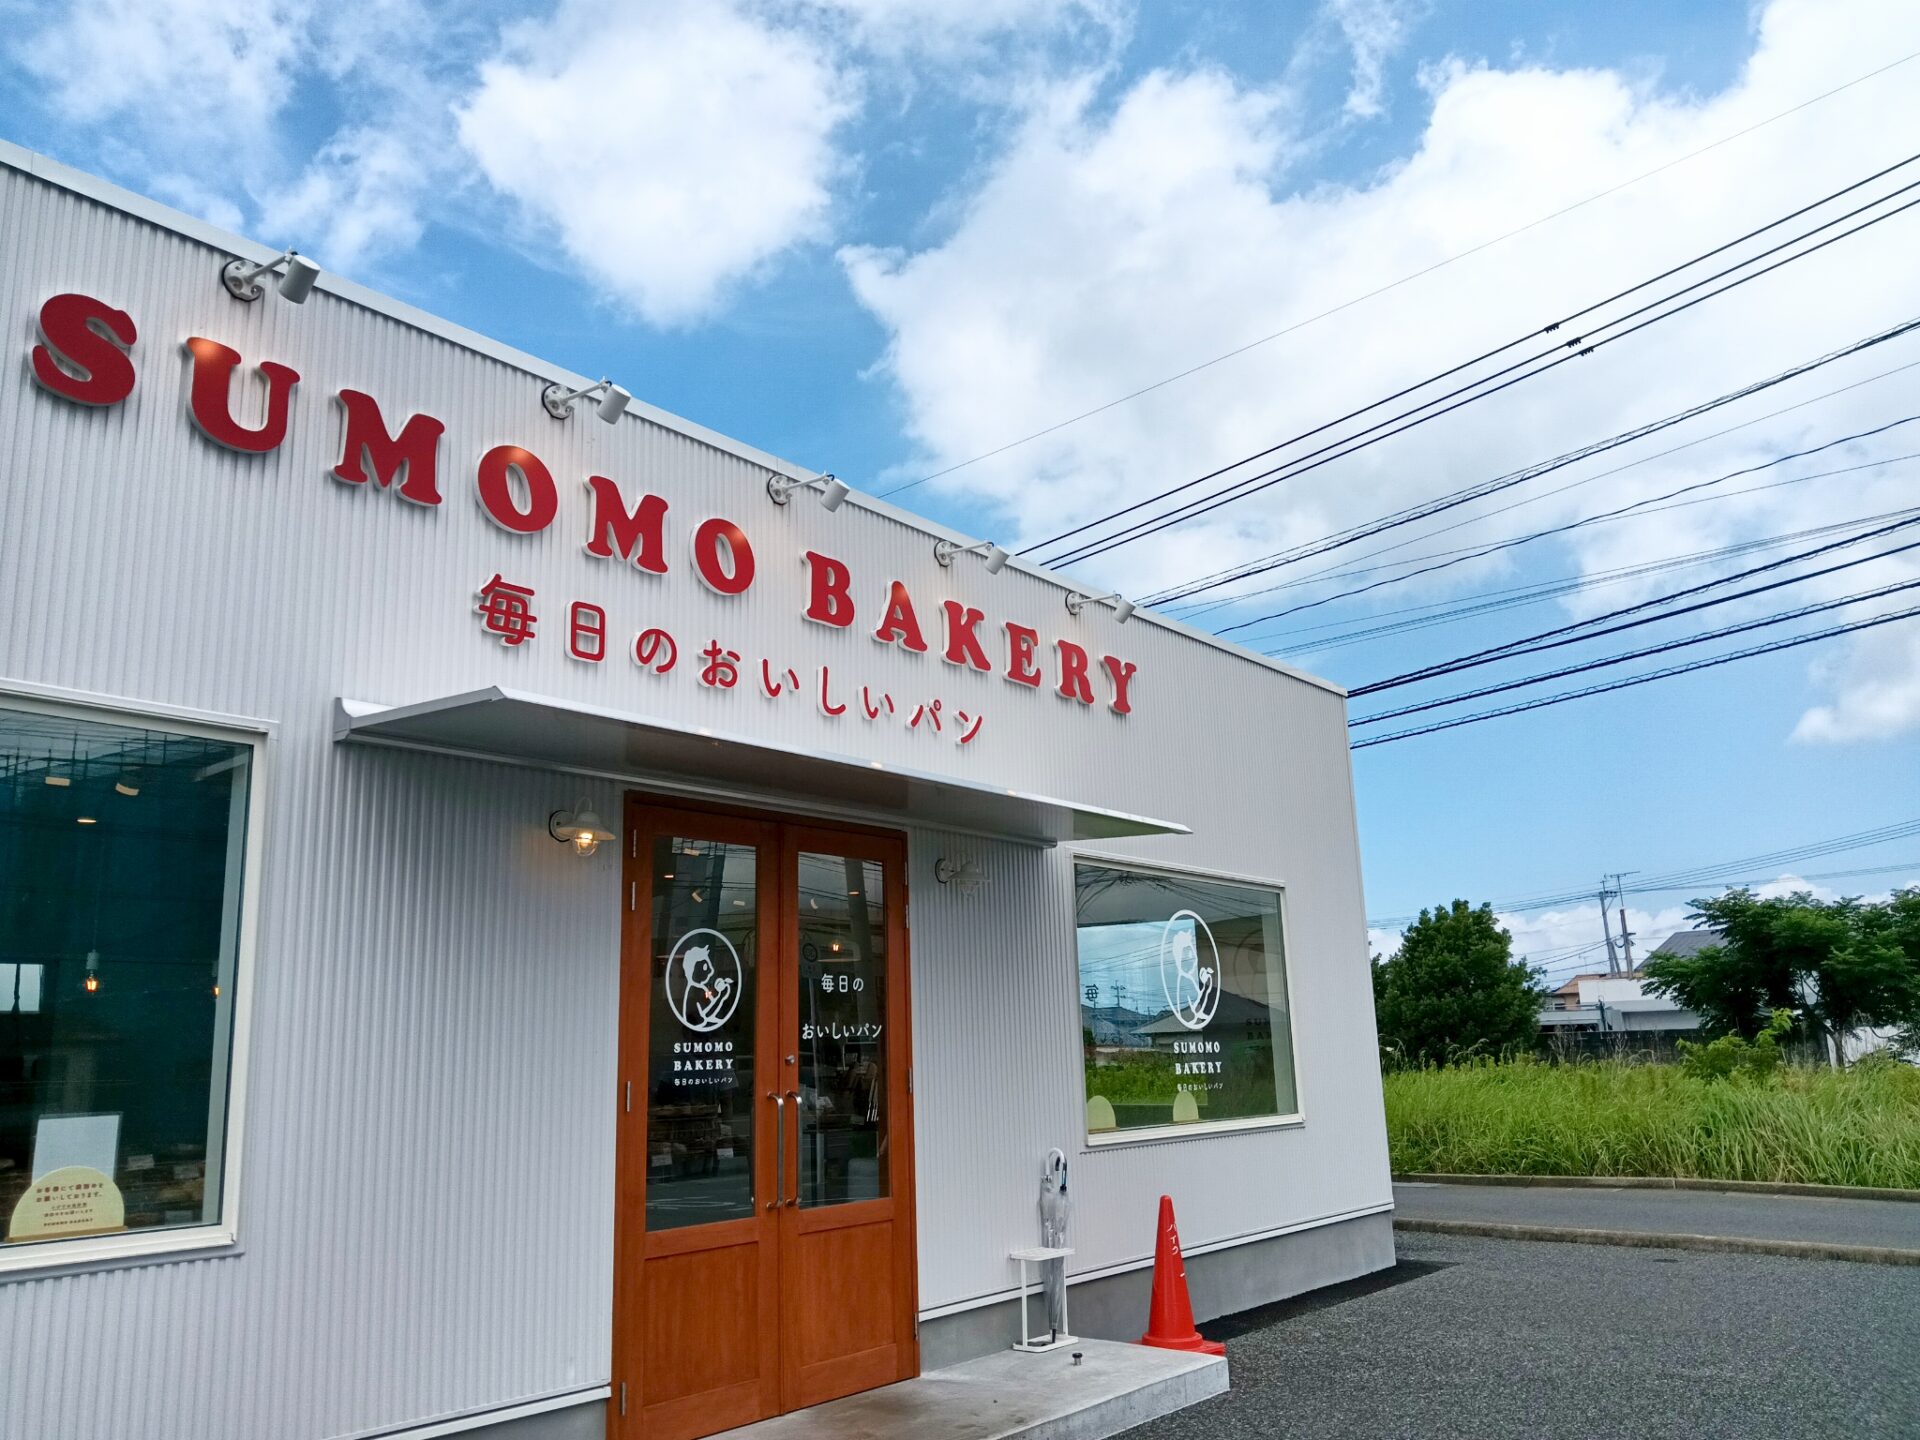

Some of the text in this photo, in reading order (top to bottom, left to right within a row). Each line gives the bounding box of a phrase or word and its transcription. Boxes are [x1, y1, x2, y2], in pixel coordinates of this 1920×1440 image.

[31, 293, 1138, 714] SUMOMO BAKERY
[473, 574, 983, 745] 毎日のおいしいパン
[821, 973, 864, 993] 毎日の
[801, 1022, 883, 1040] おいしいパン
[673, 1041, 733, 1053] SUMOMO
[1173, 1041, 1221, 1054] SUMOMO
[673, 1058, 734, 1071] BAKERY
[1174, 1061, 1222, 1075] BAKERY
